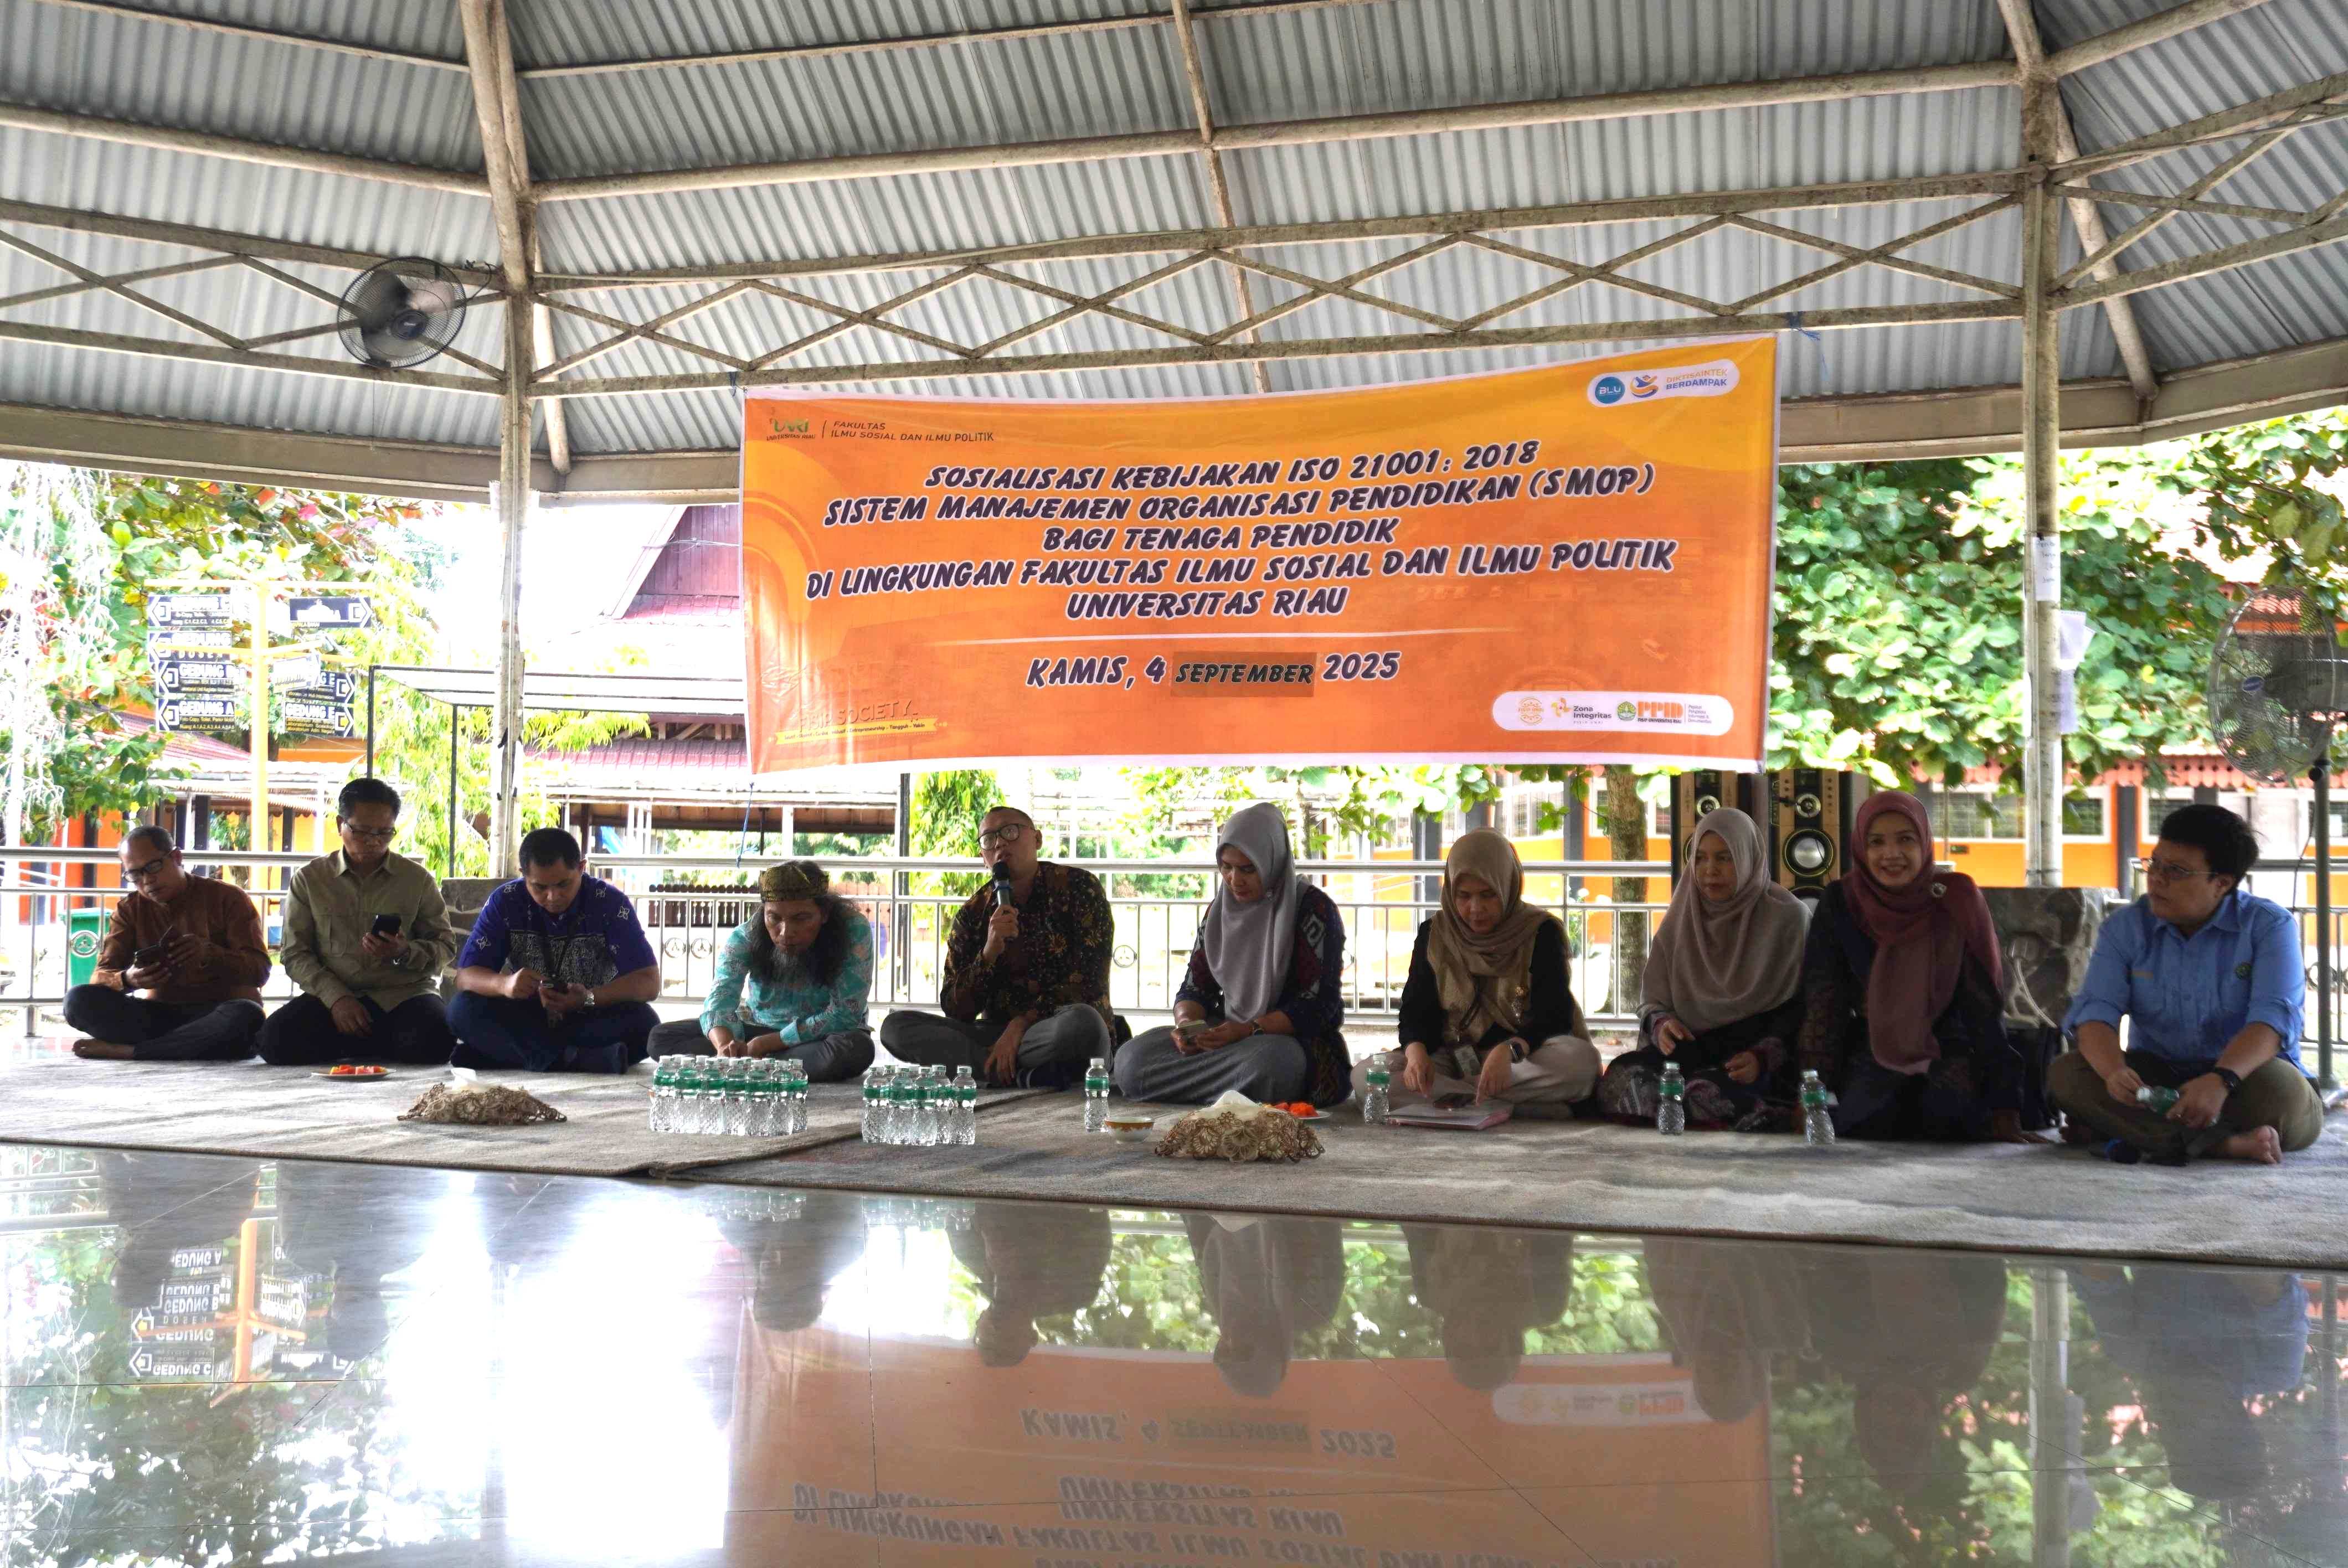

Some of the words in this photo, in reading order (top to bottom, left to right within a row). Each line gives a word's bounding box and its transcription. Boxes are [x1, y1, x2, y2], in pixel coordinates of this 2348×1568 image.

[1666, 369, 1727, 383] DIKTISAINTEK
[1598, 386, 1620, 395] BLU
[1666, 379, 1727, 390] BERDAMPAK
[833, 421, 886, 430] FAKULTAS
[859, 432, 896, 440] SOSIAL
[954, 432, 994, 441] POLITIK
[924, 466, 1106, 491] SOSIALISASI
[1110, 461, 1281, 492] KEBIJAKAN
[1287, 457, 1341, 483] ISO
[1349, 448, 1451, 479] 21001:
[1463, 440, 1540, 471] 2018
[823, 496, 928, 527] SISTEM
[936, 494, 1132, 520] MANAJEMEN
[1138, 488, 1321, 522] ORGANISASI
[1329, 474, 1521, 514] PENDIDIKAN
[1528, 463, 1655, 498] (SMOP)
[1042, 527, 1117, 551] BAGI
[1123, 525, 1242, 551] TENAGA
[1249, 517, 1400, 549] PENDIDIK
[806, 570, 834, 600] DI
[840, 560, 1015, 596] LINGKUNGAN
[1019, 559, 1169, 586] FAKULTAS
[1175, 558, 1257, 584] ILMU
[1263, 551, 1371, 582] SOSIAL
[1382, 546, 1450, 576] DAN
[1457, 545, 1542, 575] ILMU
[1551, 540, 1677, 571] POLITIK
[1066, 590, 1265, 620] UNIVERSITAS
[1272, 586, 1348, 617] RIAU
[179, 664, 224, 677] GEDUNG
[1026, 656, 1135, 690] KAMIS,
[1145, 656, 1166, 683] 4
[1176, 664, 1312, 683] SEPTEMBER
[1322, 651, 1400, 680] 2025
[179, 701, 224, 714] GEDUNG
[285, 703, 327, 719] GEDUNG
[1638, 702, 1683, 718] PPID
